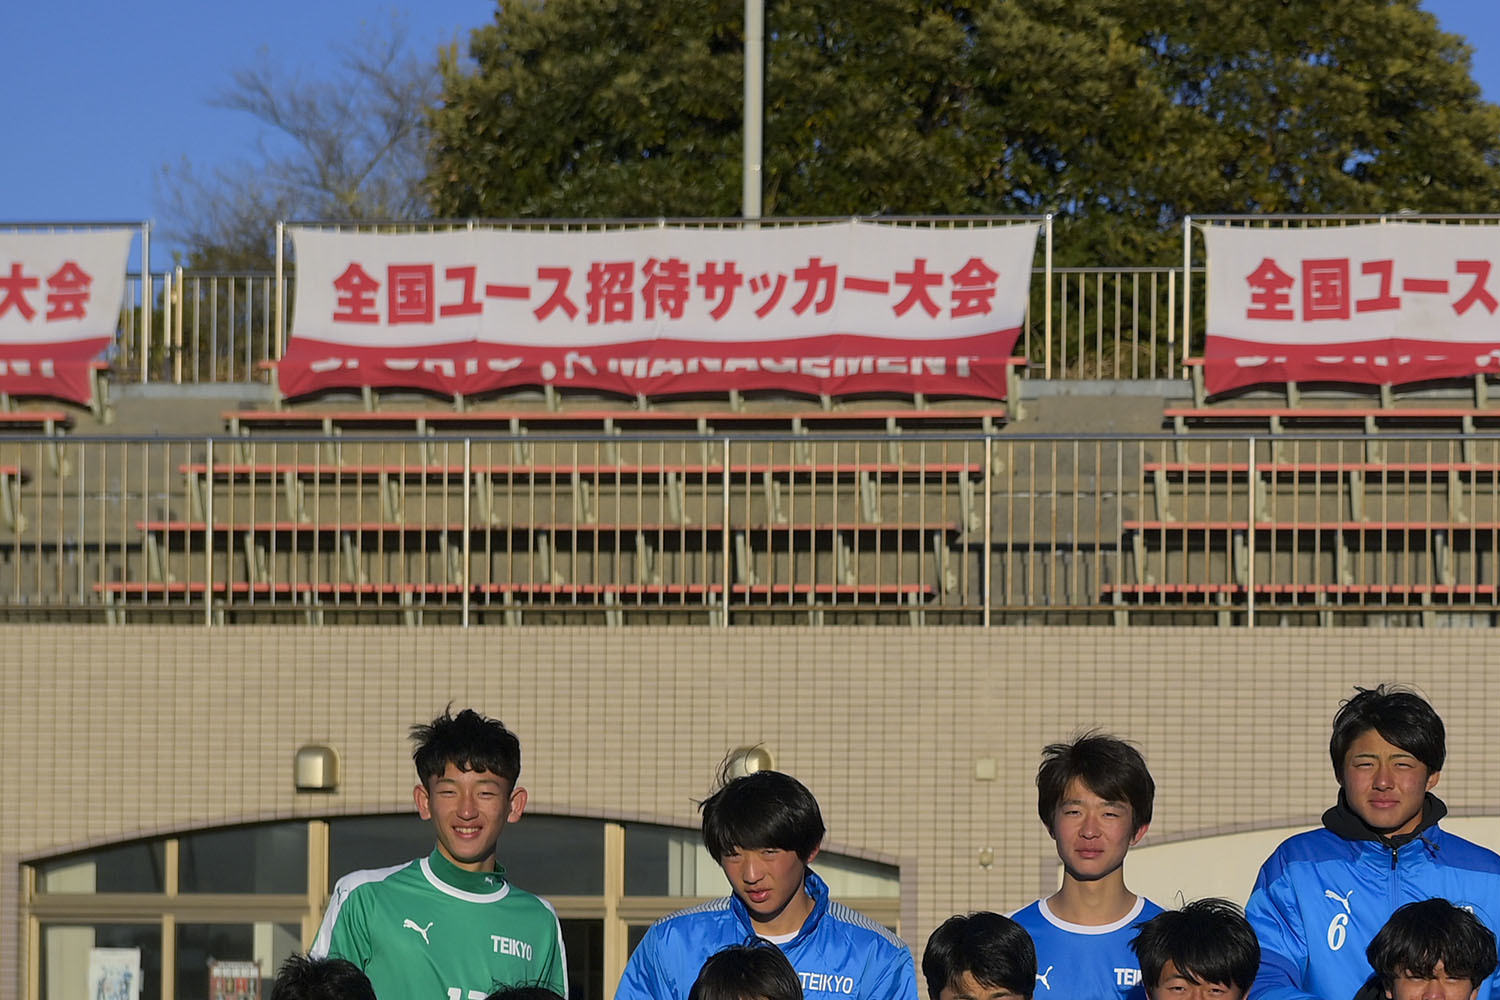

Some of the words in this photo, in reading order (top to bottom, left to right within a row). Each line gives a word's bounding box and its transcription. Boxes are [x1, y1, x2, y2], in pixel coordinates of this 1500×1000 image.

[333, 257, 1000, 326] 全国ユース招待サッカー大会
[490, 934, 532, 961] TEIKYO
[1328, 912, 1350, 951] 6
[799, 972, 854, 993] TEIKYO
